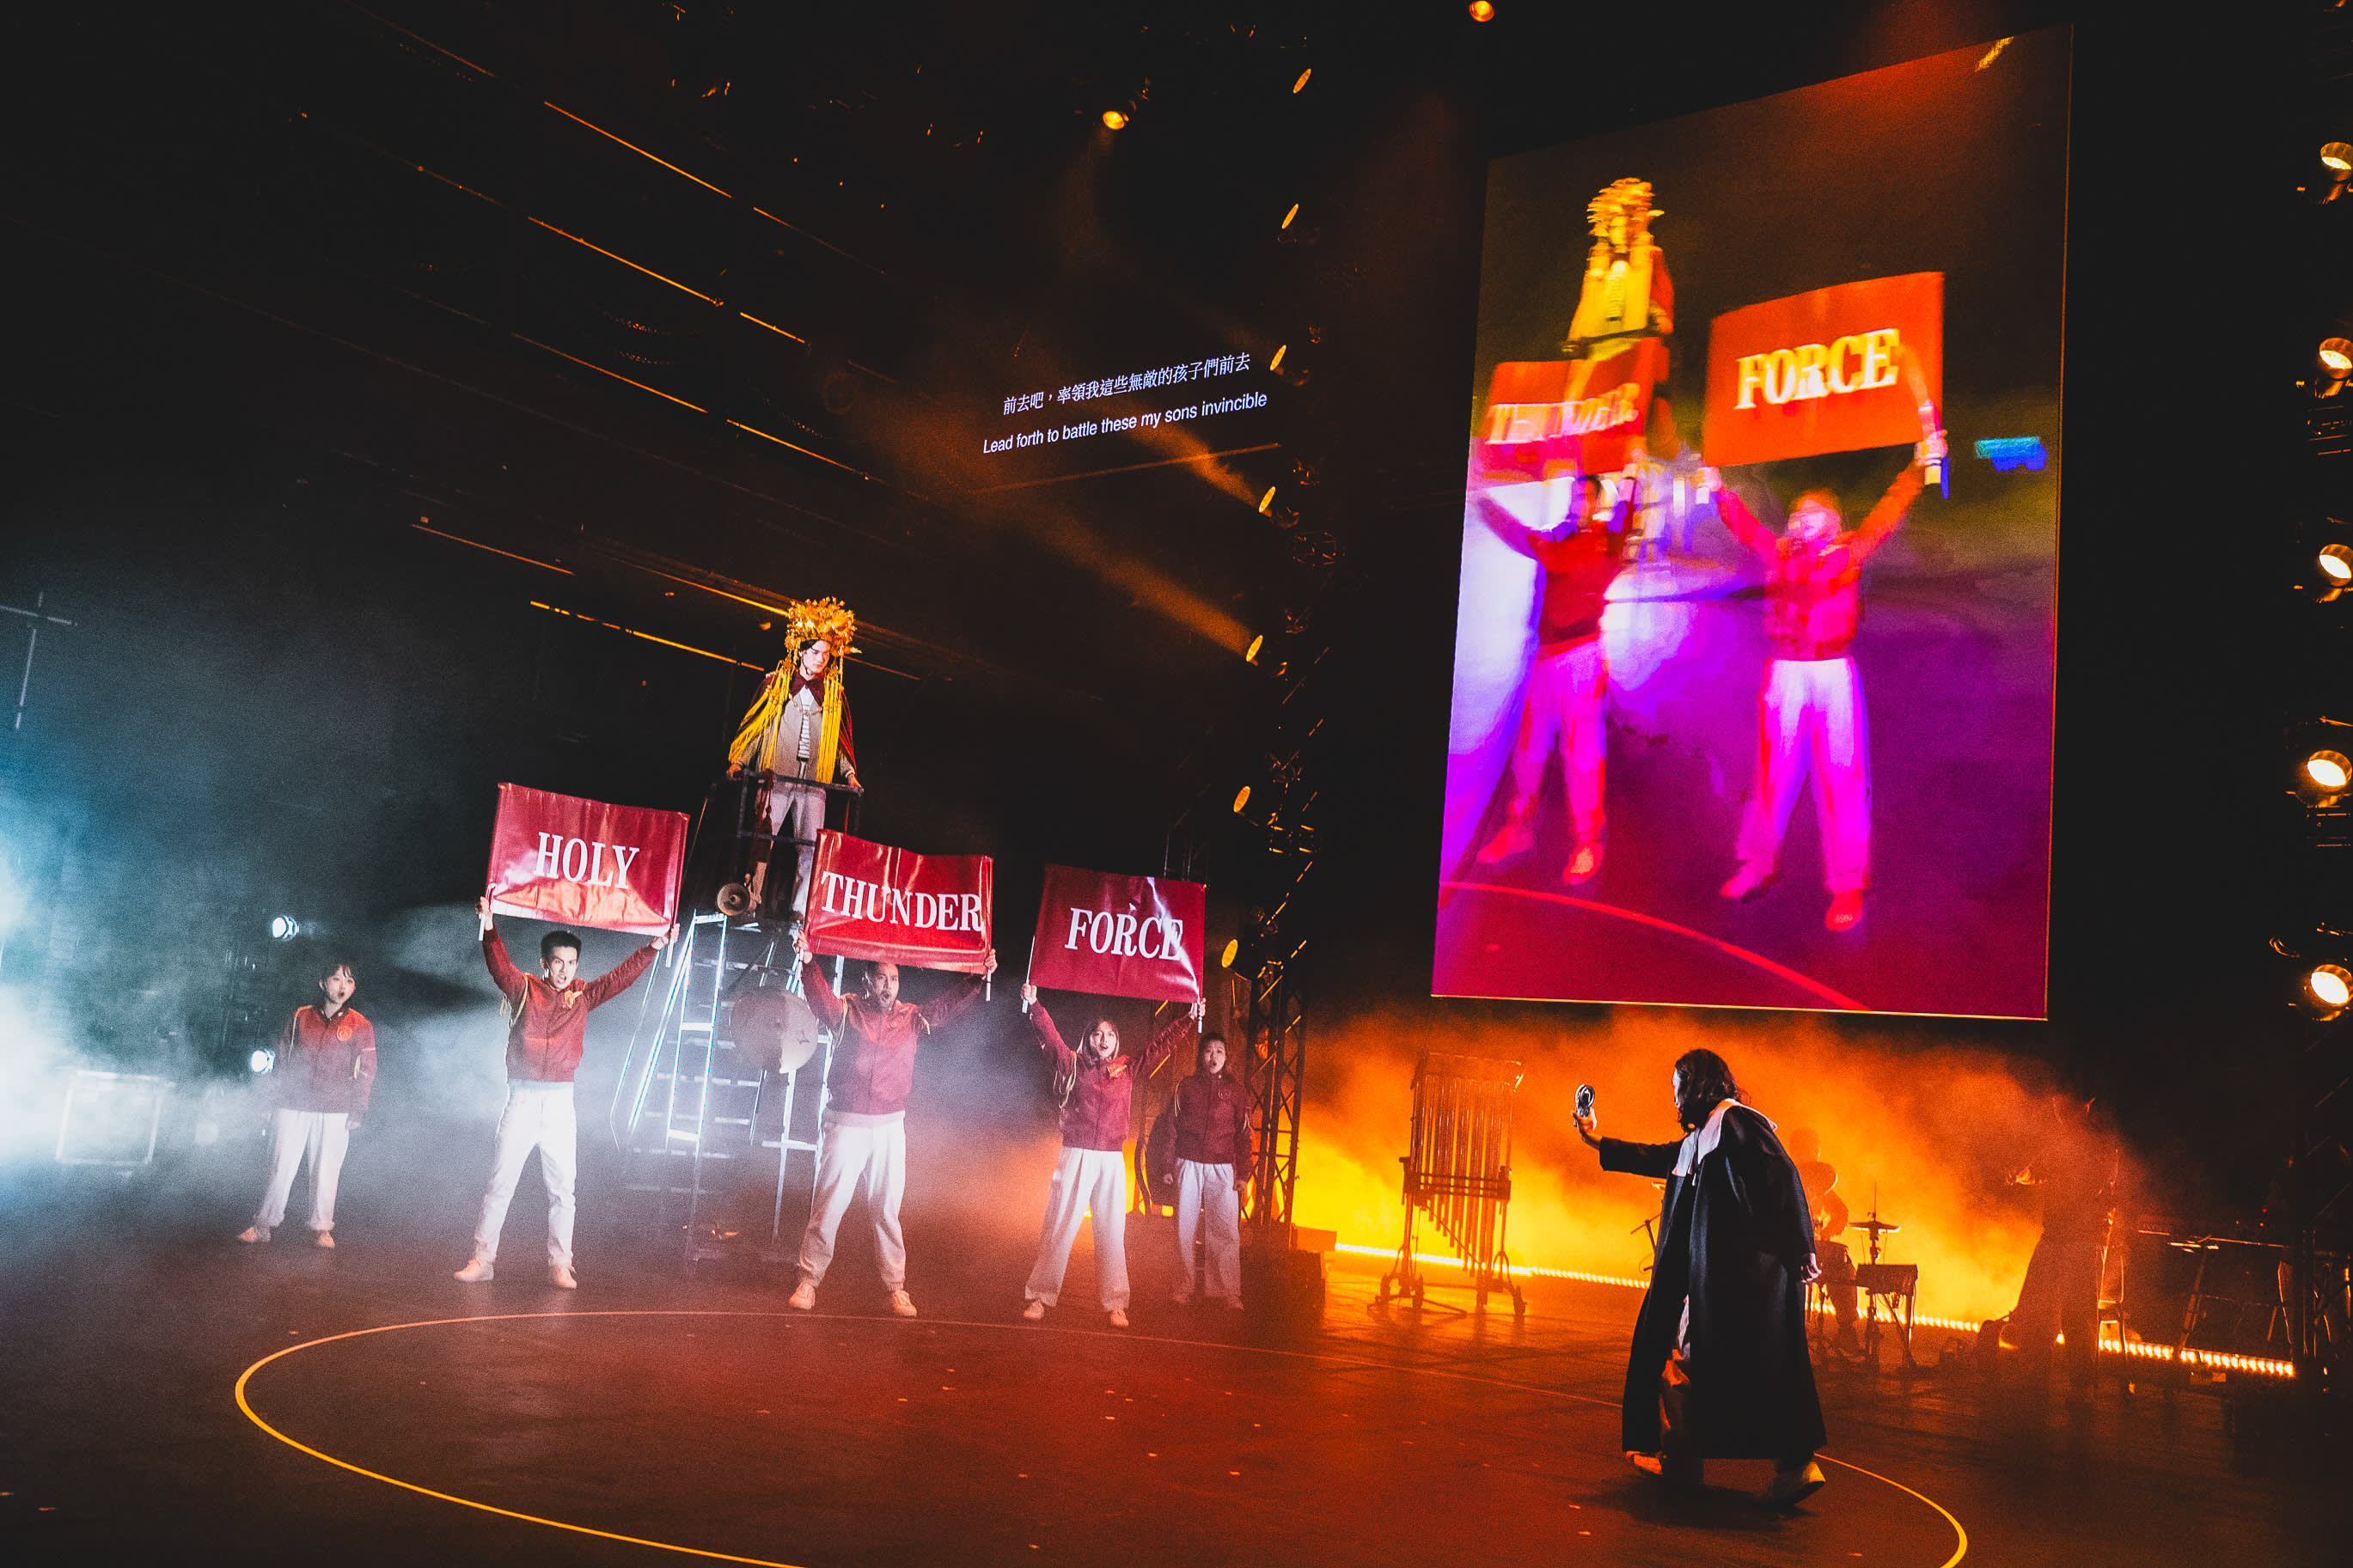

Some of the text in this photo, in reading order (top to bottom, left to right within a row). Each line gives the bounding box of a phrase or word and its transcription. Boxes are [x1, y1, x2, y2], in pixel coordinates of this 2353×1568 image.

[1735, 327, 1900, 410] FORCE
[983, 392, 1268, 454] Lead forth to battle these my sons invincible
[535, 831, 641, 889] HOLY
[821, 870, 983, 933] THUNDER
[1064, 907, 1184, 961] FORCE
